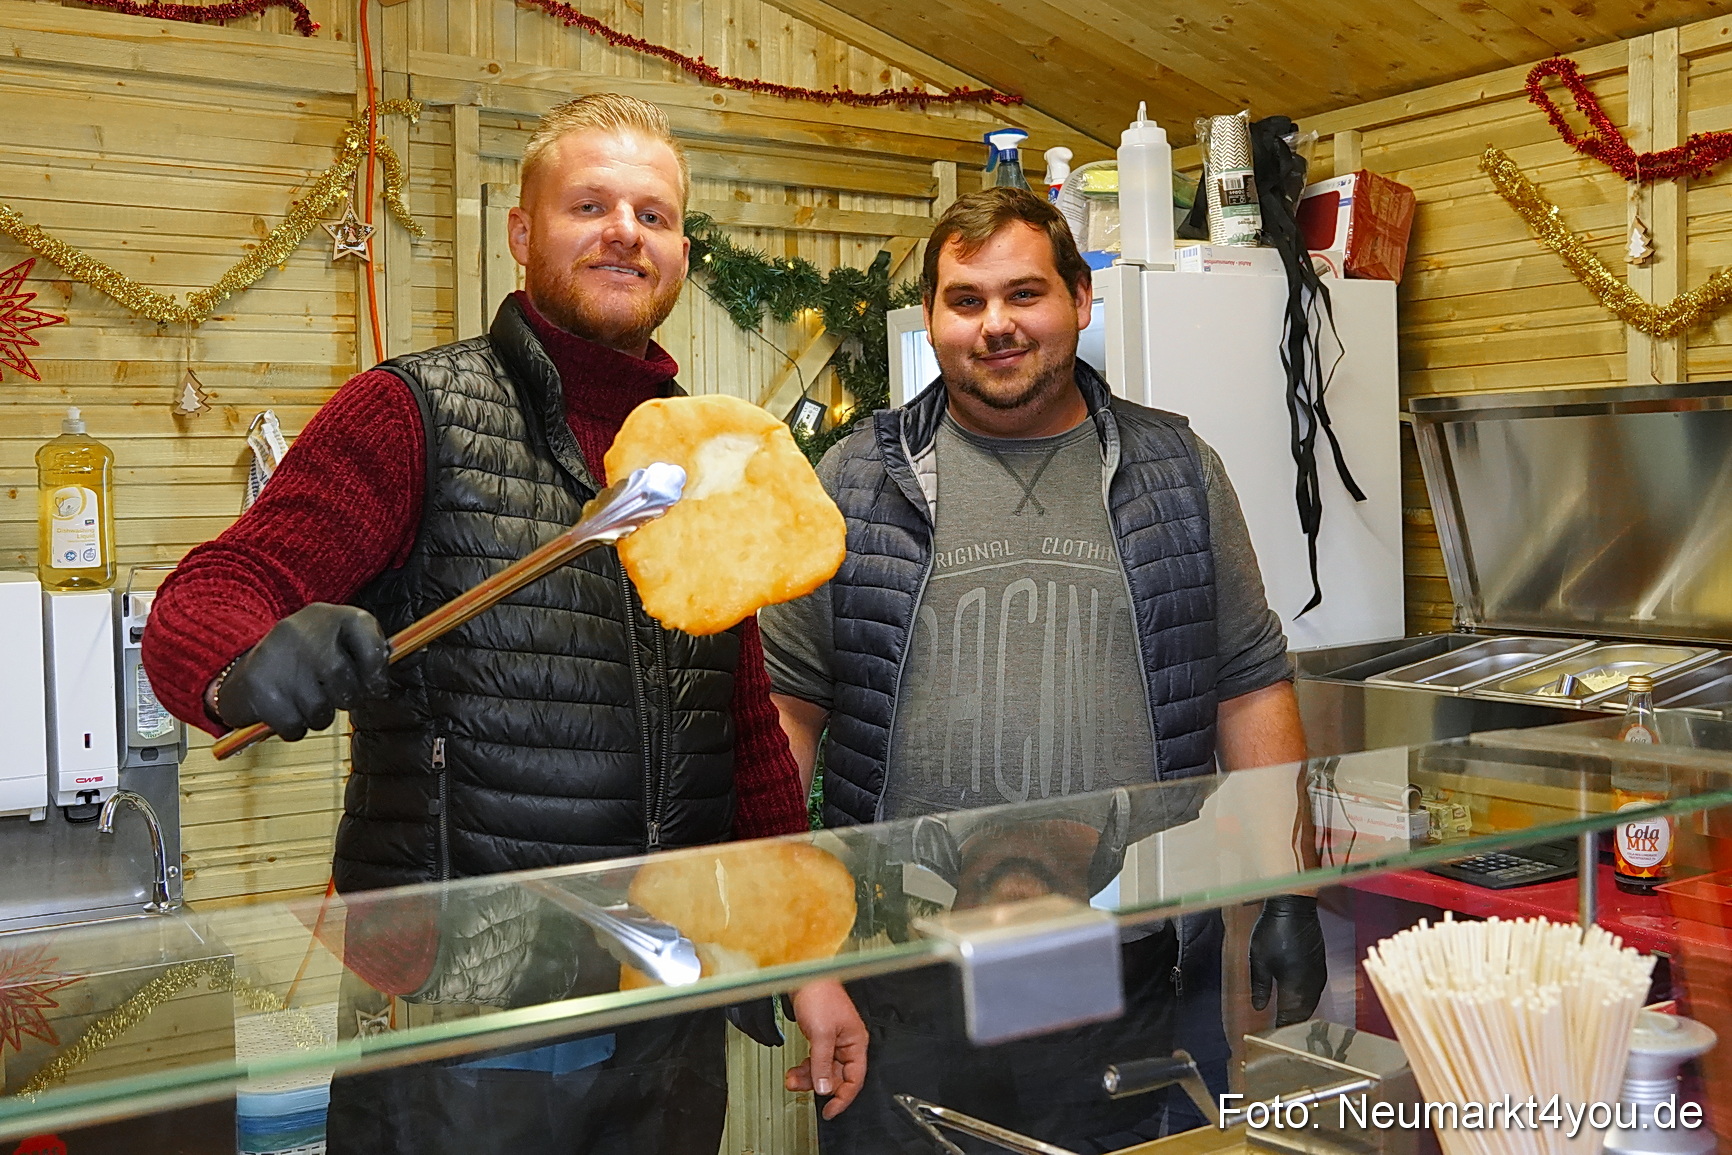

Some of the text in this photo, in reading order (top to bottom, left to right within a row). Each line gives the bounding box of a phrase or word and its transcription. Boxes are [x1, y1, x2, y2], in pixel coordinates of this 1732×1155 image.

[934, 536, 1118, 569] RIGINAL CLOTHIN
[1625, 823, 1660, 840] Cola
[1626, 837, 1659, 852] MIX
